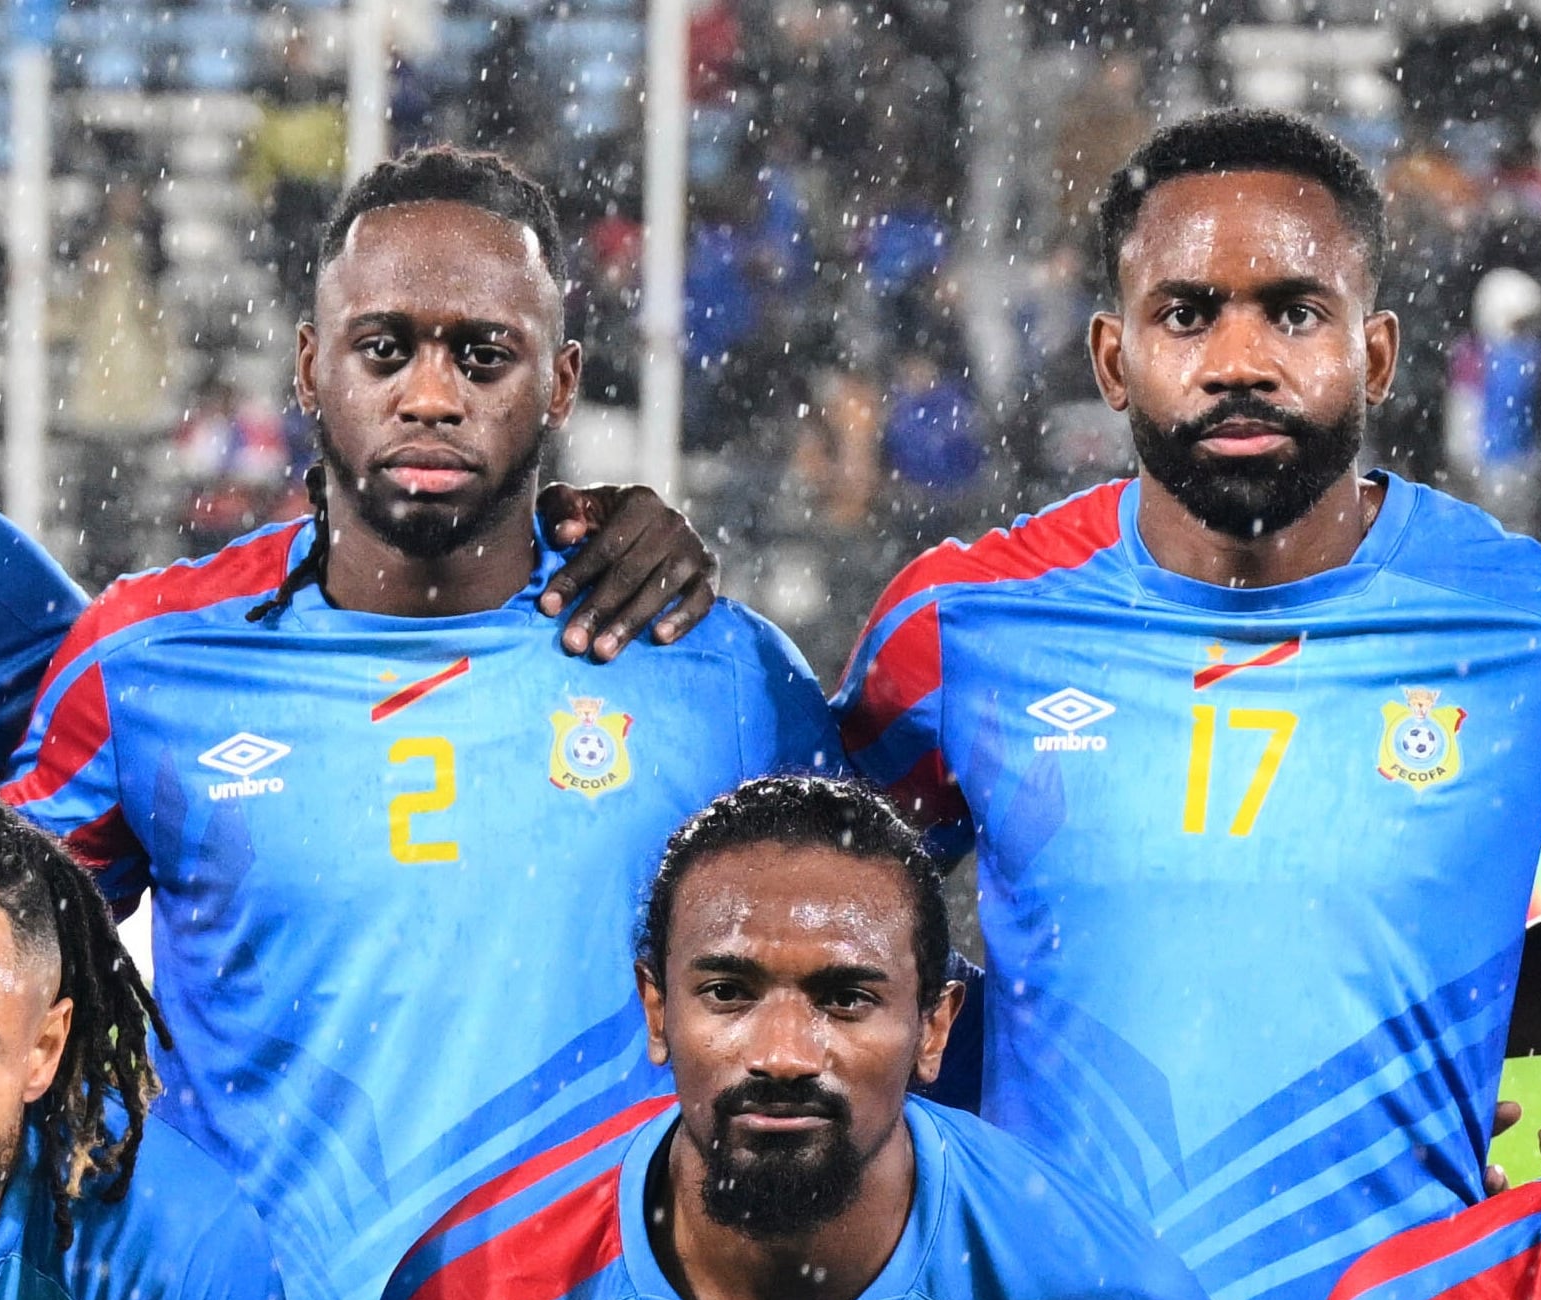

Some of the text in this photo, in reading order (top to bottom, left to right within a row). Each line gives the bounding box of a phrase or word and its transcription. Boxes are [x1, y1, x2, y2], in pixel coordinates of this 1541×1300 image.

[1033, 731, 1108, 751] umbro
[562, 772, 617, 789] FECOFA
[1182, 704, 1299, 837] 17
[1391, 763, 1446, 781] FECOFA
[209, 776, 284, 800] umbro
[389, 736, 459, 864] 2
